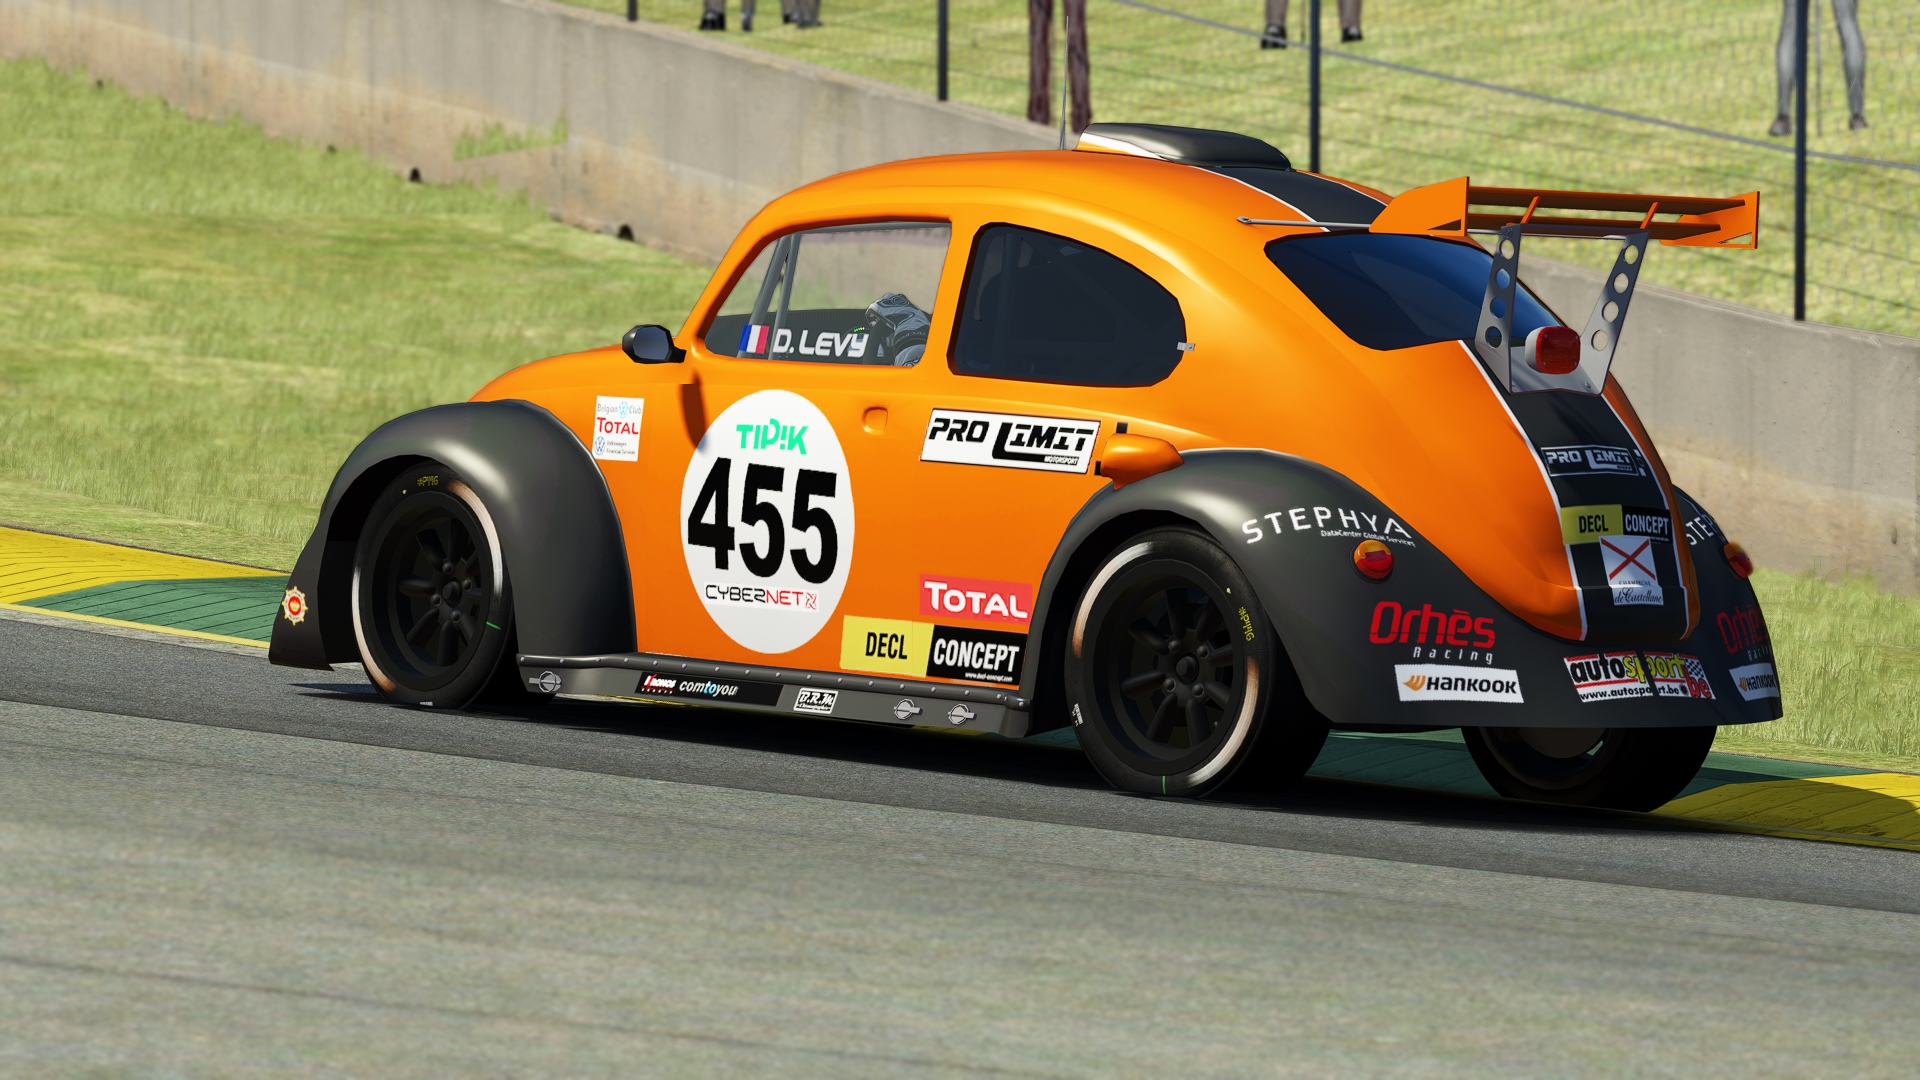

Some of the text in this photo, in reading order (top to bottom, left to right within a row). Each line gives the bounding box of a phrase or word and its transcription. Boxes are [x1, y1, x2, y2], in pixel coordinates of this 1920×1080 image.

[773, 328, 869, 358] D. LEVY
[596, 416, 639, 435] TOTAL
[928, 417, 1094, 464] PRO LIMIT
[1545, 449, 1631, 470] PRO LIMIT
[688, 457, 838, 584] 455
[1241, 506, 1412, 544] STEPHYA
[1578, 513, 1669, 535] DECL CONCEPT
[705, 584, 804, 606] CYBERNET
[924, 581, 1028, 618] TOTAL
[1614, 587, 1662, 604] de Castellane
[865, 632, 1019, 672] DECL CONCEPT
[1412, 646, 1493, 665] Racing
[1570, 652, 1686, 684] autosport
[1684, 667, 1712, 699] be
[679, 680, 736, 697] comtoyou
